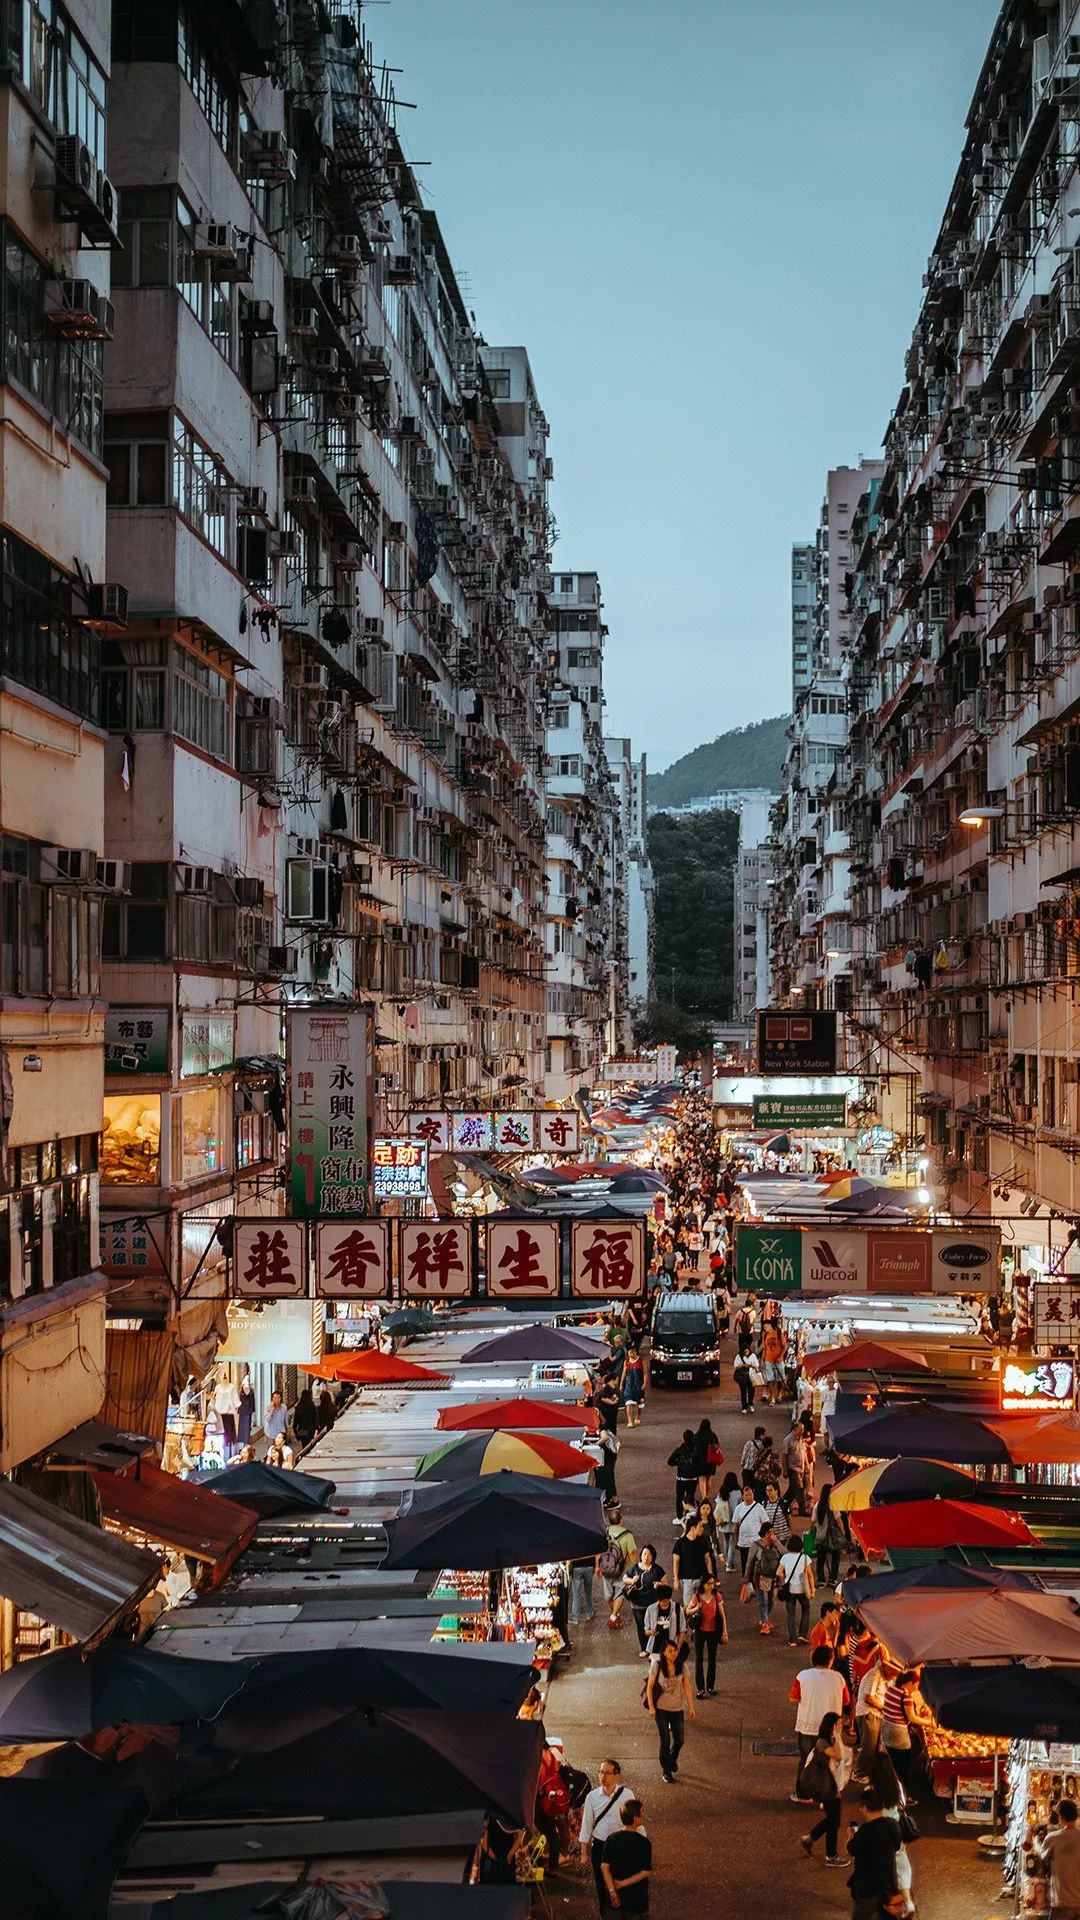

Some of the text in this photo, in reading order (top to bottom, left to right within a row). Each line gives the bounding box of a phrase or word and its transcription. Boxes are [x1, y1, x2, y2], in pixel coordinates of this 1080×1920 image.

[329, 1064, 355, 1151] 永興隆
[746, 1257, 794, 1281] LEONA
[880, 1258, 920, 1271] Triumph
[810, 1268, 857, 1281] Wacoal
